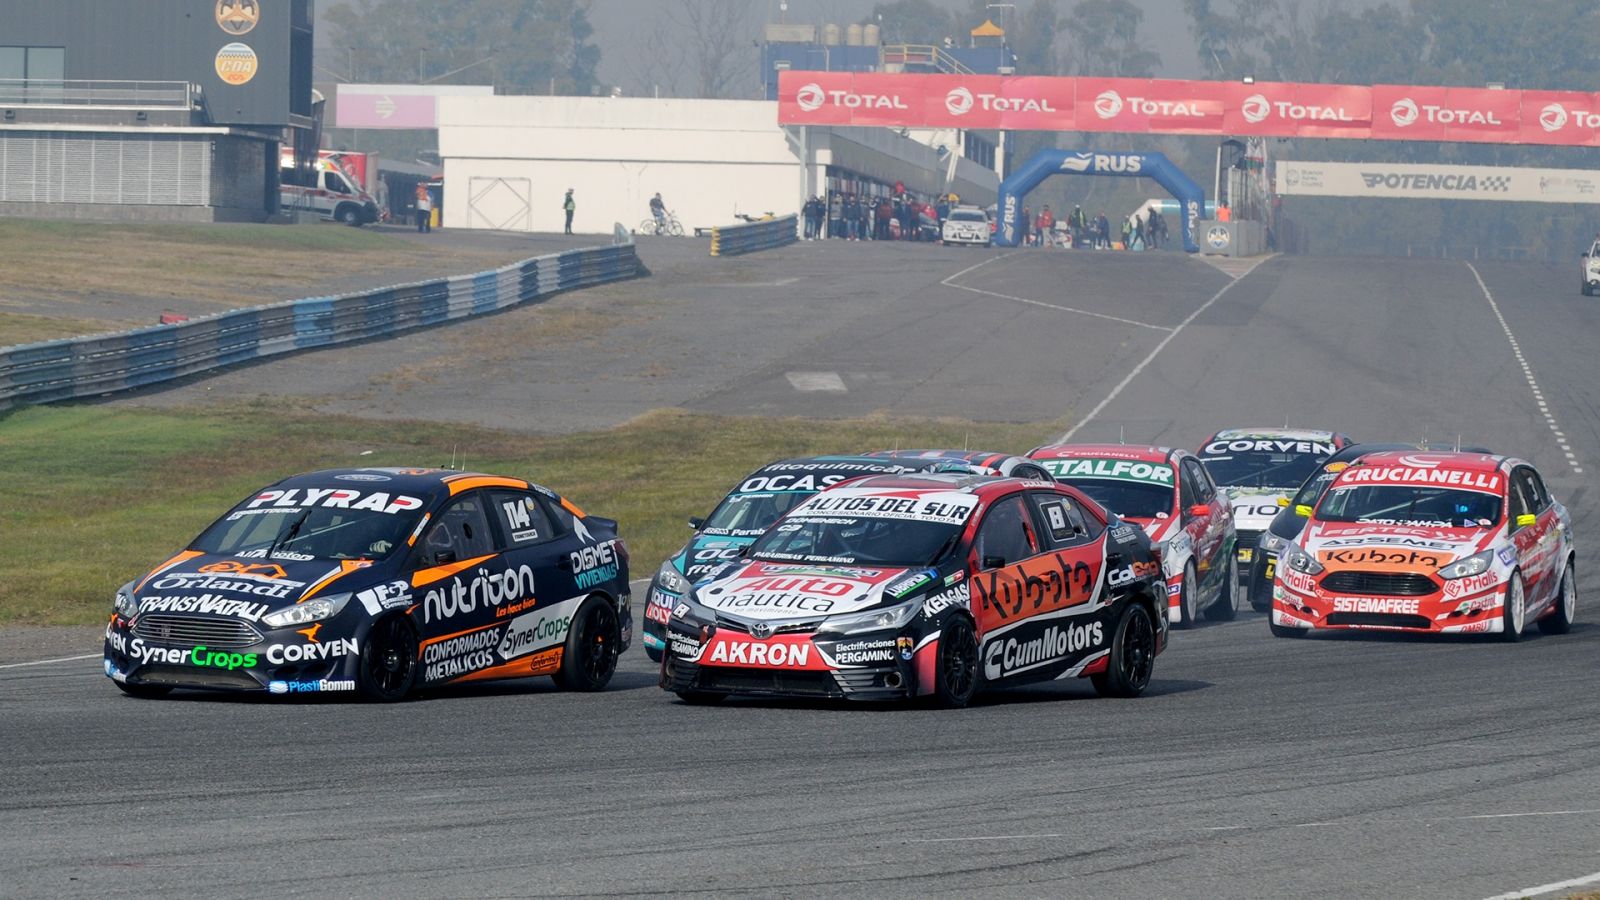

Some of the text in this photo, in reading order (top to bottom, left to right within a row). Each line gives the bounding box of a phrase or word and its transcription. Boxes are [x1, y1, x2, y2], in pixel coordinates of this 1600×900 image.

[1094, 155, 1141, 172] RUS
[1360, 172, 1477, 191] POTENCIA
[1205, 441, 1336, 455] CORVEN
[1342, 468, 1499, 489] CRUCIANELLI
[246, 488, 423, 514] PLYRAP
[802, 498, 878, 511] AUTOS
[877, 499, 918, 515] DEL
[921, 502, 970, 520] SUR
[503, 499, 530, 529] 114
[921, 515, 956, 523] TOYOTA
[1047, 506, 1065, 530] 8
[1327, 550, 1440, 567] Kubota
[152, 576, 294, 599] Orlandi
[974, 553, 1092, 619] Kubota
[717, 593, 835, 612] nautica
[1333, 597, 1420, 613] SISTEMAFREE
[424, 627, 500, 664] CONFORMADOS
[503, 615, 570, 655] SynerCrops
[835, 639, 896, 653] Electrificaciones
[1003, 620, 1103, 671] CumMotors
[130, 638, 257, 670] SynerCrops
[266, 637, 359, 665] CORVEN
[710, 640, 809, 667] AKRON
[425, 648, 494, 682] METALICOS
[289, 679, 355, 692] PlastiGomm
